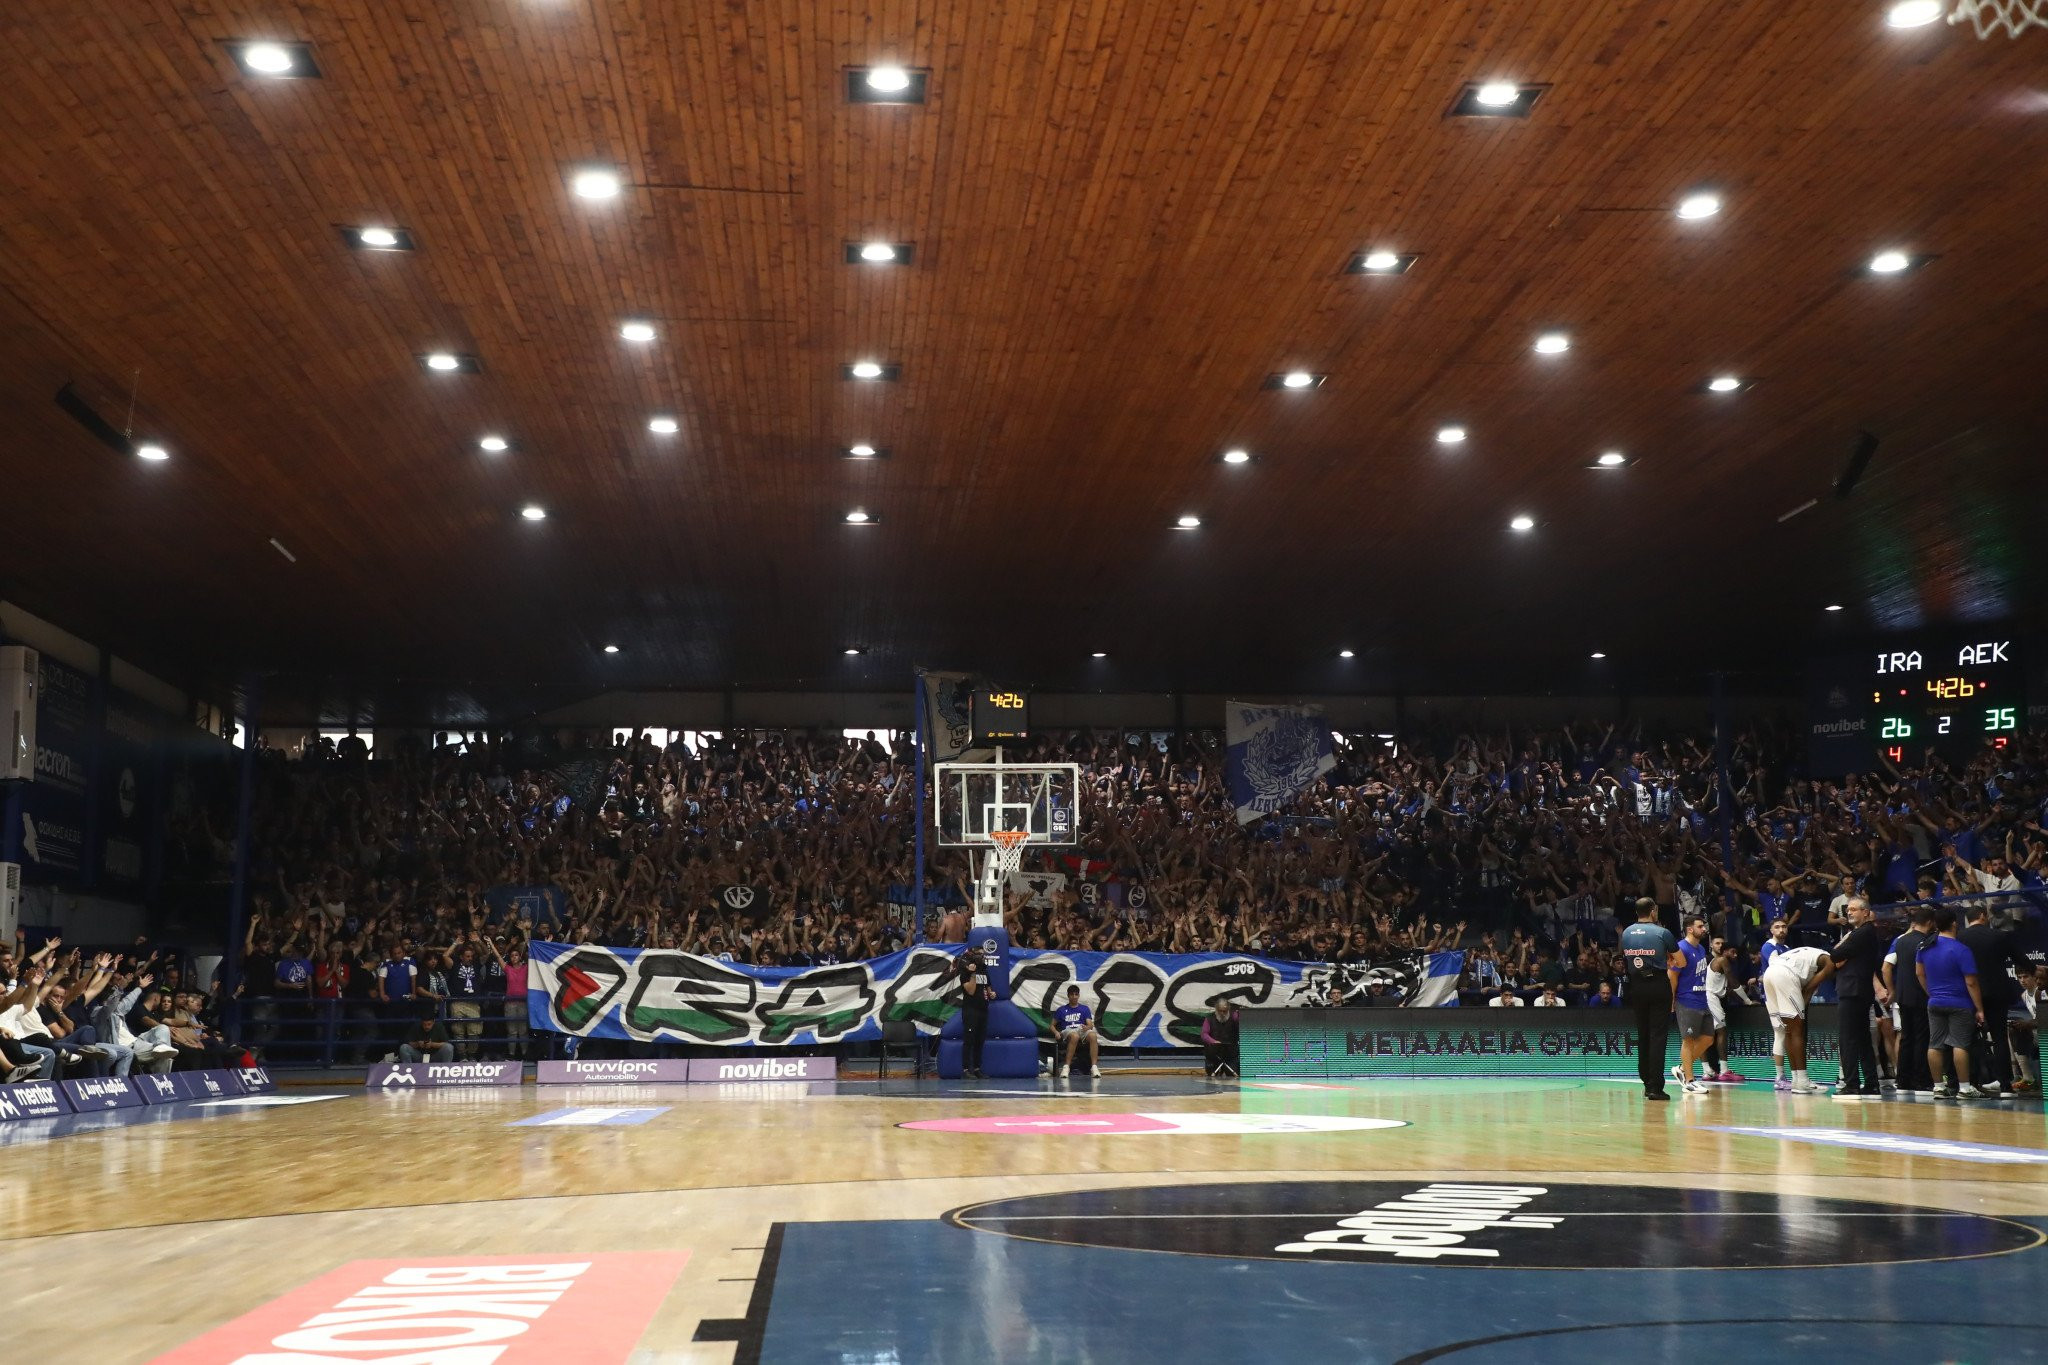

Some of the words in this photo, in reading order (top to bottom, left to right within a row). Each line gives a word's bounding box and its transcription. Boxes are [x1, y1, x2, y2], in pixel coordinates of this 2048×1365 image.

[1876, 650, 1923, 674] IRA
[1958, 641, 2010, 666] AEK
[1927, 677, 1974, 699] 4:26
[989, 693, 1024, 708] 4:26
[1813, 717, 1867, 735] novibet
[1881, 717, 1912, 739] 26
[1937, 716, 1951, 734] 2
[1985, 707, 2016, 731] 35
[35, 744, 71, 780] acron
[1889, 746, 1902, 763] 4
[1224, 963, 1255, 976] 1908
[1346, 1031, 1529, 1055] ΜΕΤΑΛΛΕΙΑ
[1540, 1031, 1639, 1055] ΘΡΑΚΗ
[428, 1062, 503, 1078] mentor
[566, 1060, 658, 1074] Γιαννίρης
[719, 1058, 808, 1079] novibet
[13, 1083, 57, 1106] mentor
